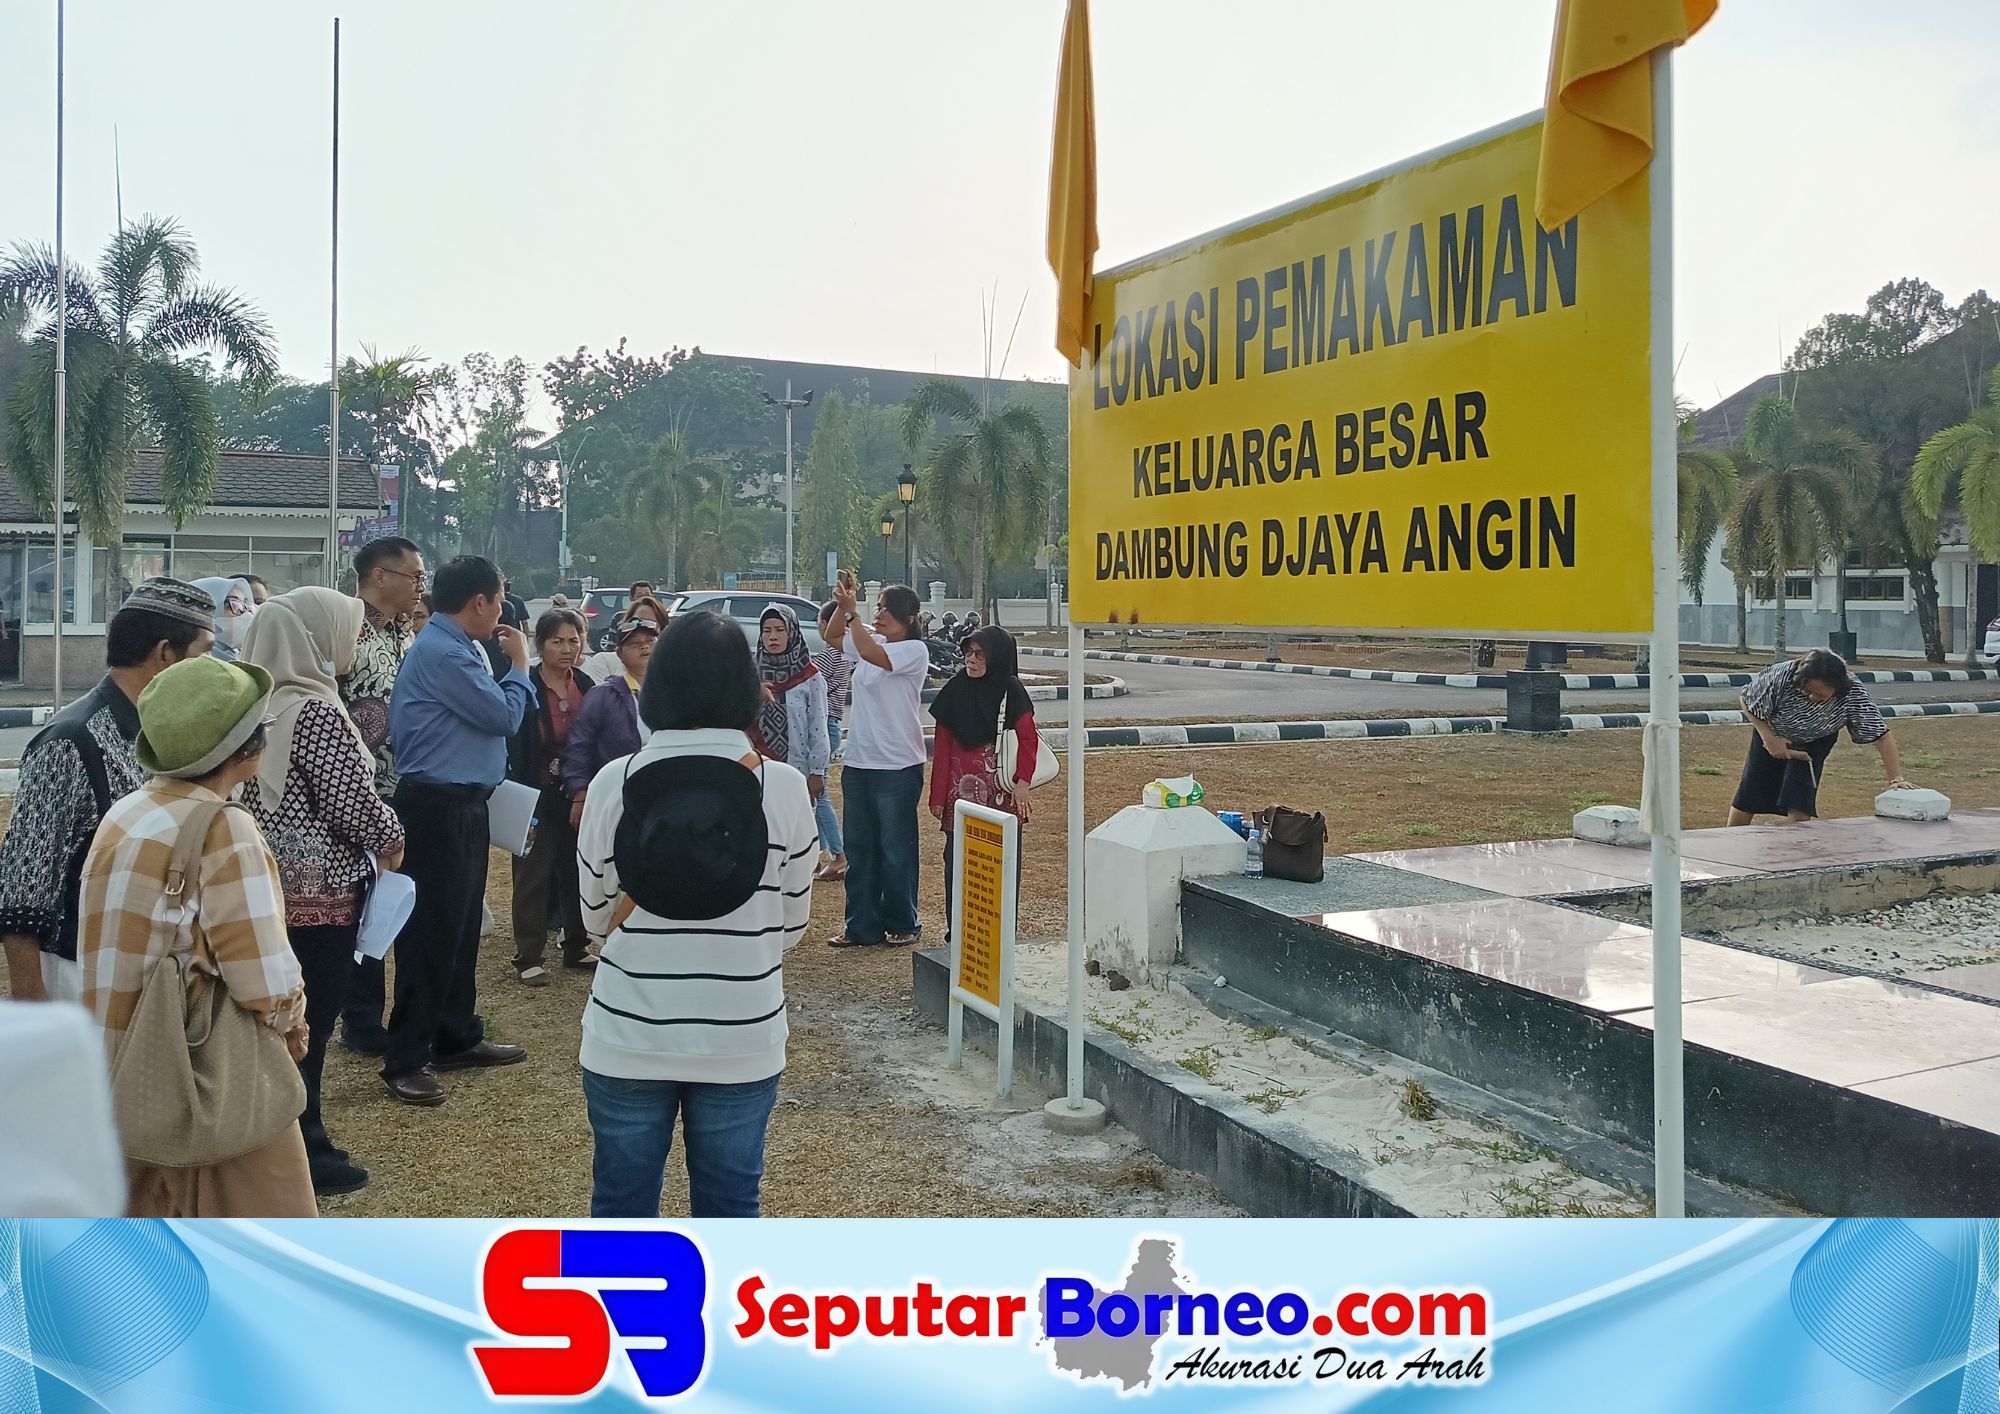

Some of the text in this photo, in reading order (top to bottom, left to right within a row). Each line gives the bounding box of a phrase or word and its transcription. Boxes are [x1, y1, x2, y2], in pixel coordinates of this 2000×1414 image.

[1093, 193, 1578, 410] LOKASI PEMAKAMAN
[1132, 390, 1489, 499] KELUARGA BESAR
[1096, 494, 1577, 581] DAMBUNG DJAYA ANGIN
